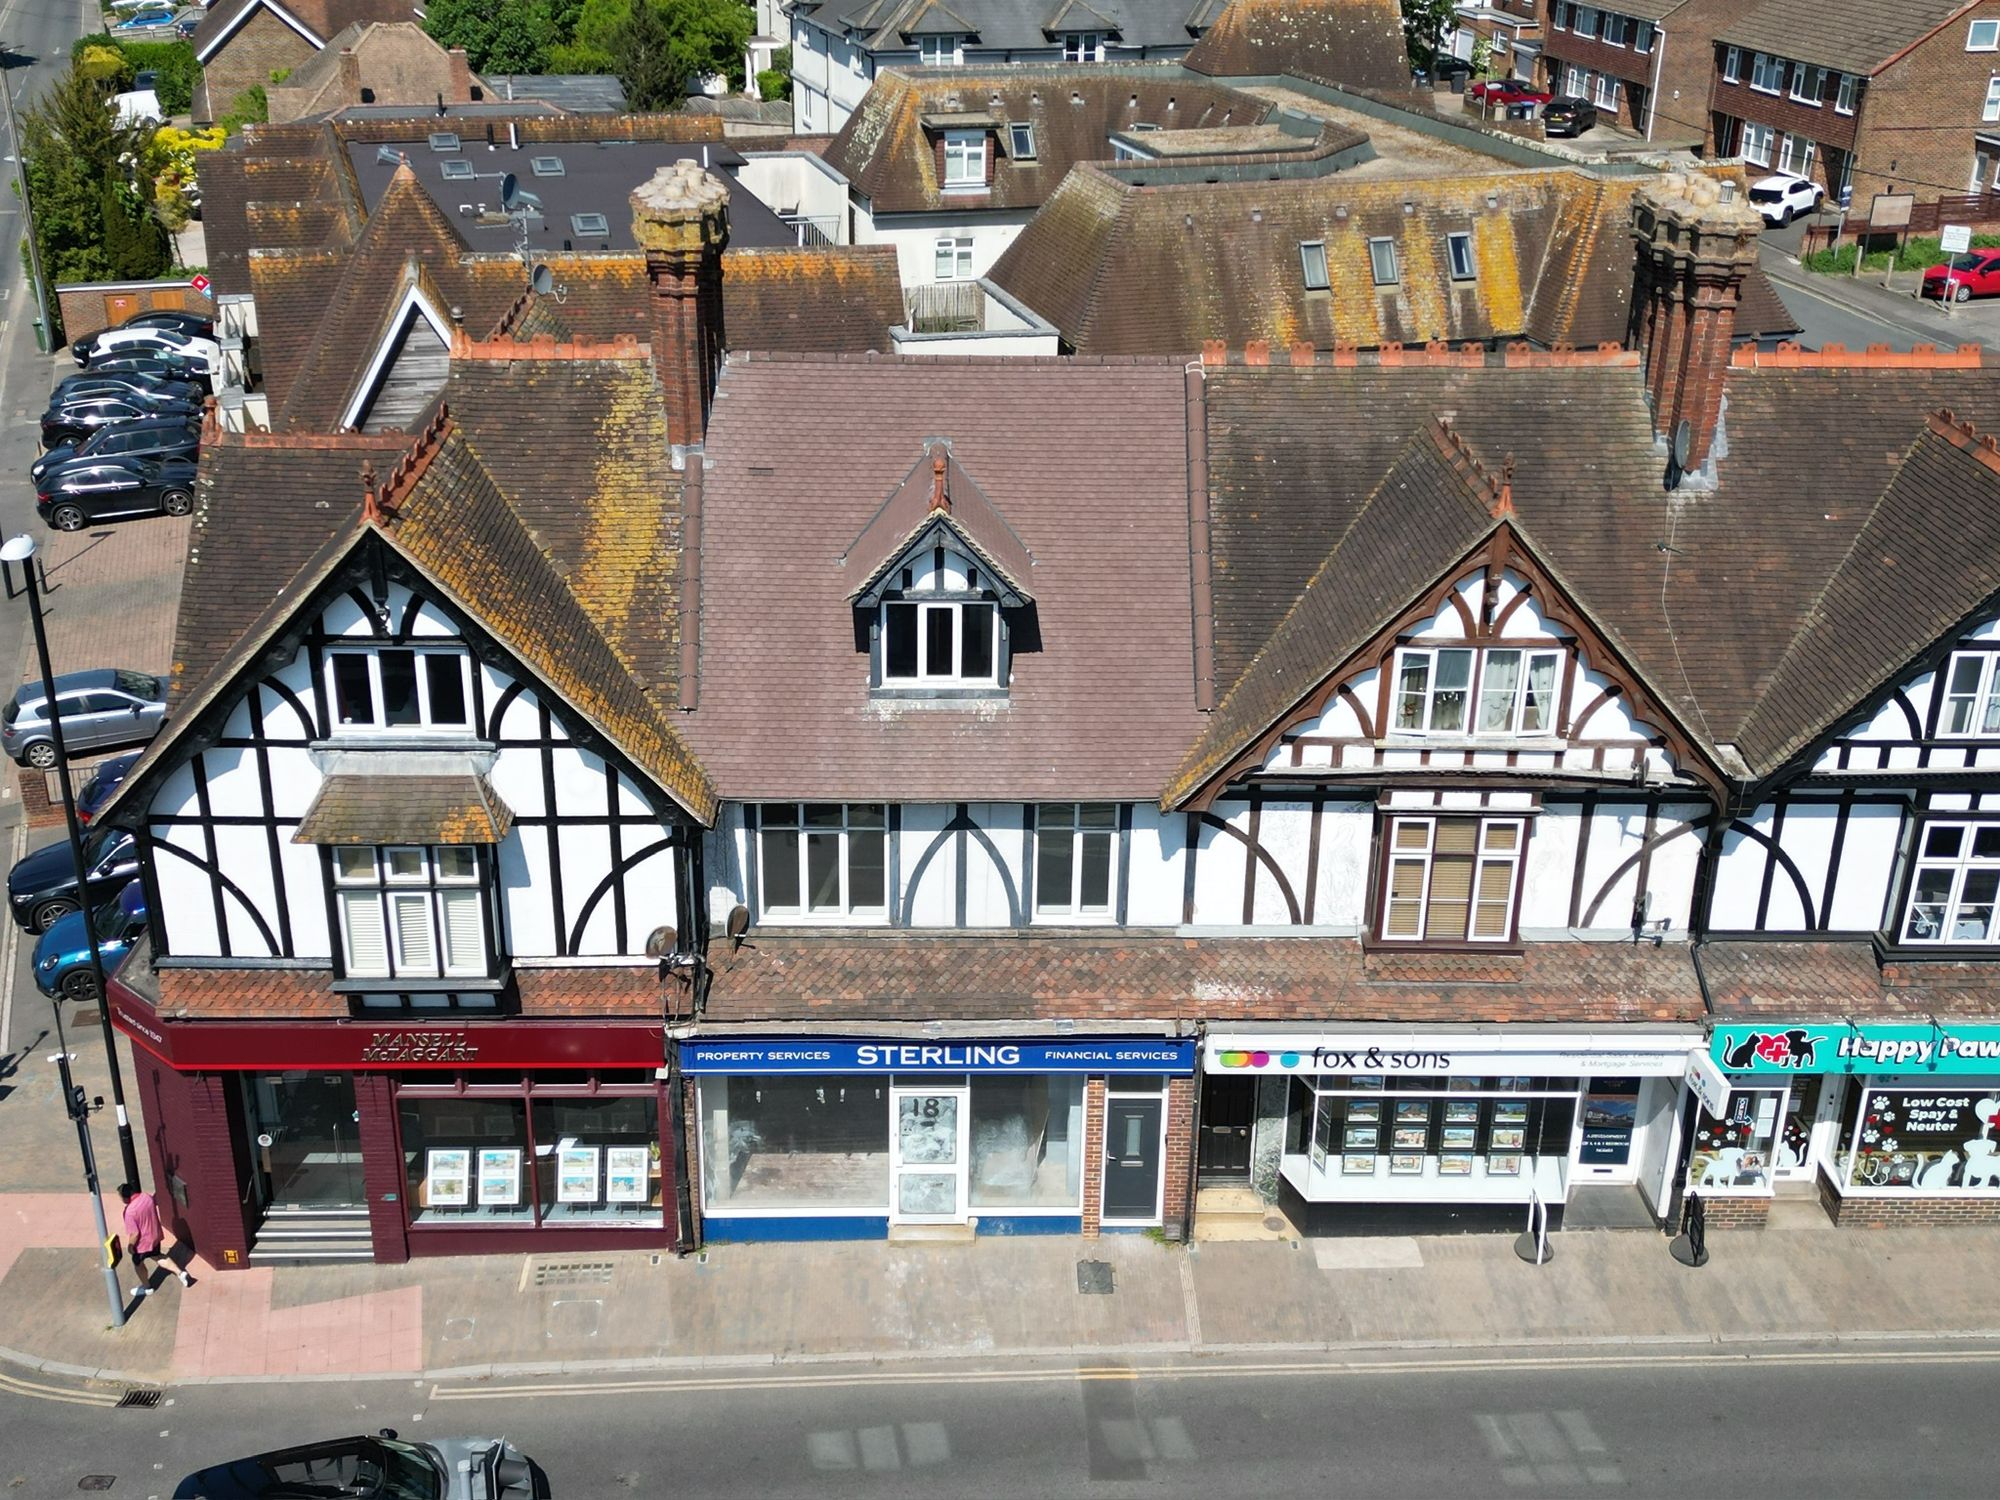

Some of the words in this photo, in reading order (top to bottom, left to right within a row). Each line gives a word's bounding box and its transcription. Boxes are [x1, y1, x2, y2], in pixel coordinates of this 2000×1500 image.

[371, 1032, 467, 1047] MANSELL
[361, 1047, 479, 1061] McTAGGART
[696, 1051, 764, 1061] PROPERTY
[767, 1051, 831, 1061] SERVICES
[856, 1045, 1020, 1065] STERLING
[1044, 1051, 1113, 1060] FINANCIAL
[1115, 1051, 1178, 1061] SERVICES
[1311, 1046, 1357, 1069] fox
[1363, 1046, 1386, 1069] &
[1390, 1051, 1451, 1069] sons
[1837, 1037, 1938, 1064] Happy
[913, 1098, 939, 1118] 18
[1902, 1097, 1935, 1107] Low
[1936, 1097, 1970, 1107] Cost
[1909, 1109, 1947, 1121] Spay
[1948, 1109, 1958, 1119] &
[1906, 1121, 1958, 1131] Neuter
